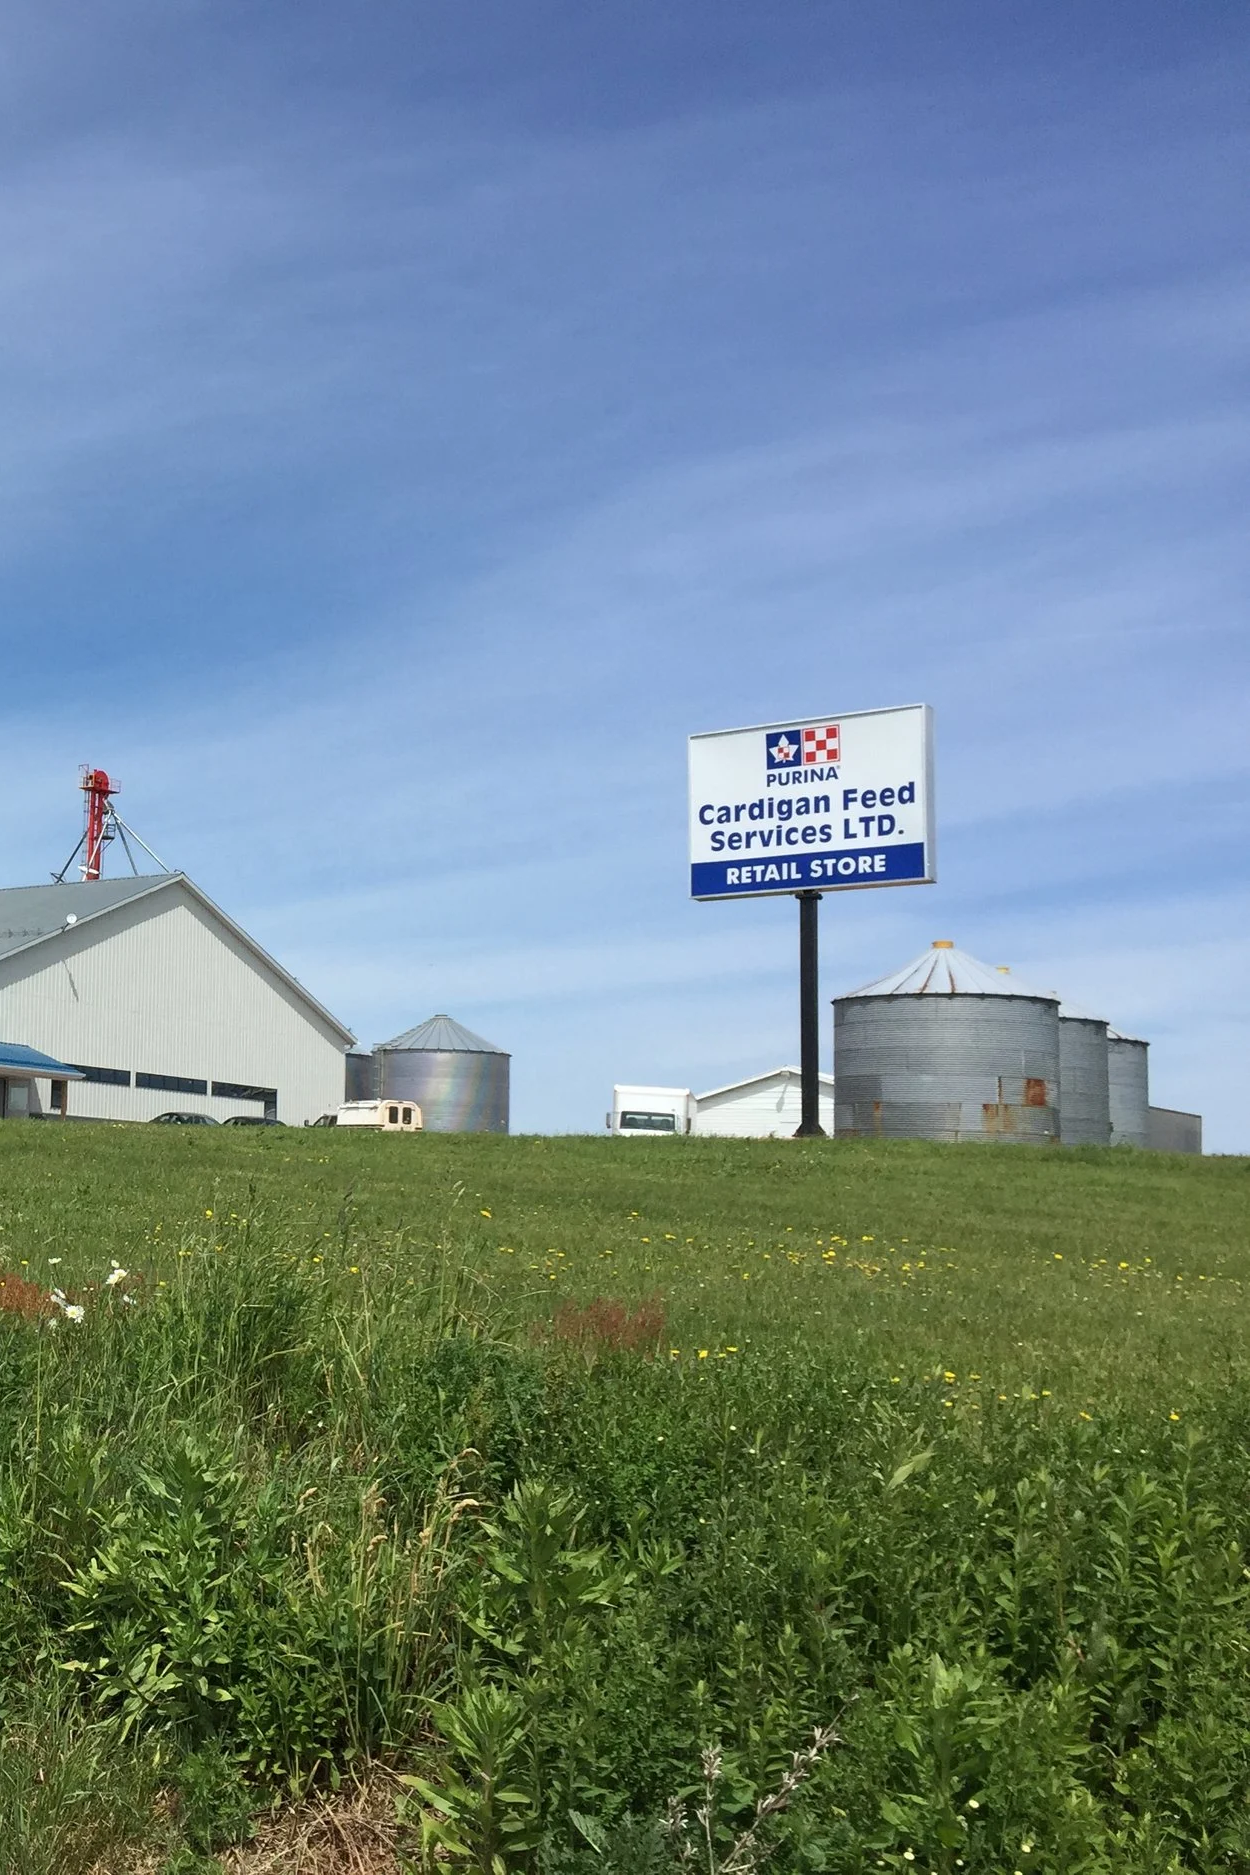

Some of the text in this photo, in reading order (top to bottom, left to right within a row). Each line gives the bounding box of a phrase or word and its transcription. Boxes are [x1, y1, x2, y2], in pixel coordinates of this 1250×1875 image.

[766, 766, 839, 787] PURINA
[699, 781, 915, 825] Cardigan Feed
[710, 814, 904, 851] Services LTD.
[726, 855, 886, 885] RETAIL STORE
